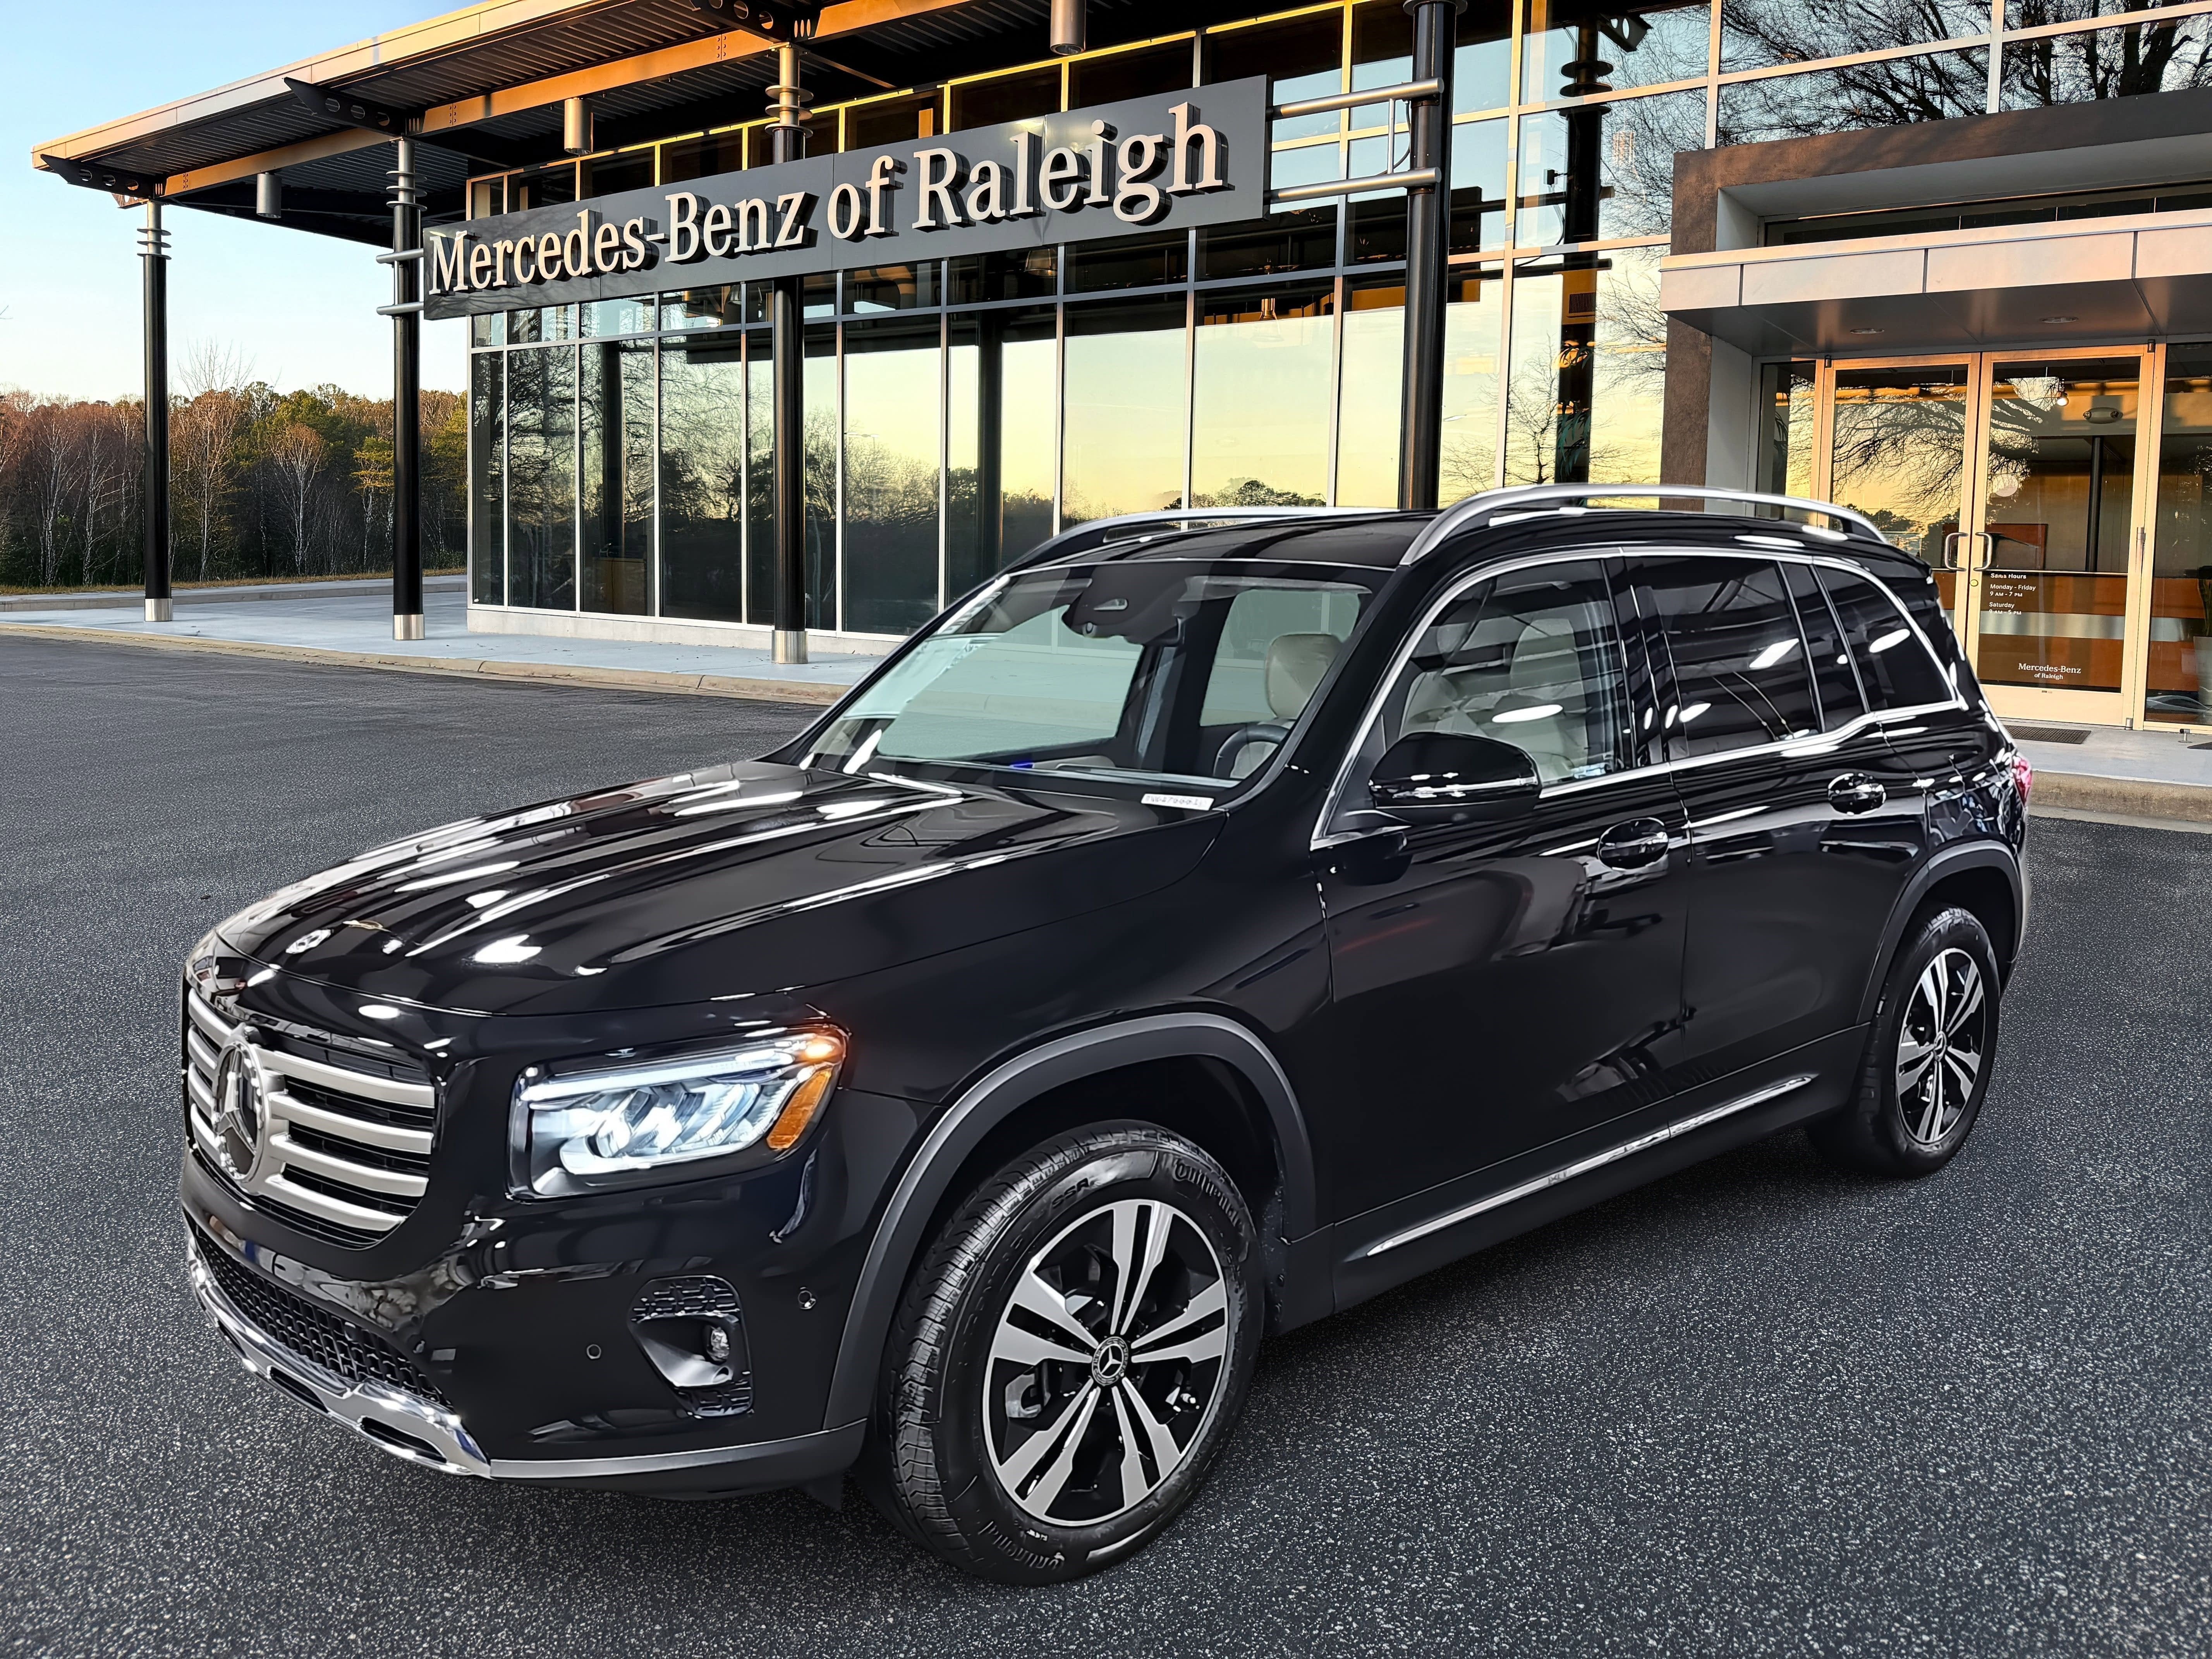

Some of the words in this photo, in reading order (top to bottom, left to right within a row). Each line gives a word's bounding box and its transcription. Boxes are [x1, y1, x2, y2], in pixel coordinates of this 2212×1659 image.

[429, 192, 806, 295] Mercedes-Benz
[827, 155, 894, 239] of
[912, 101, 1223, 228] Raleigh
[2018, 663, 2081, 673] Mercedes-Benz
[1051, 1178, 1089, 1209] SSR
